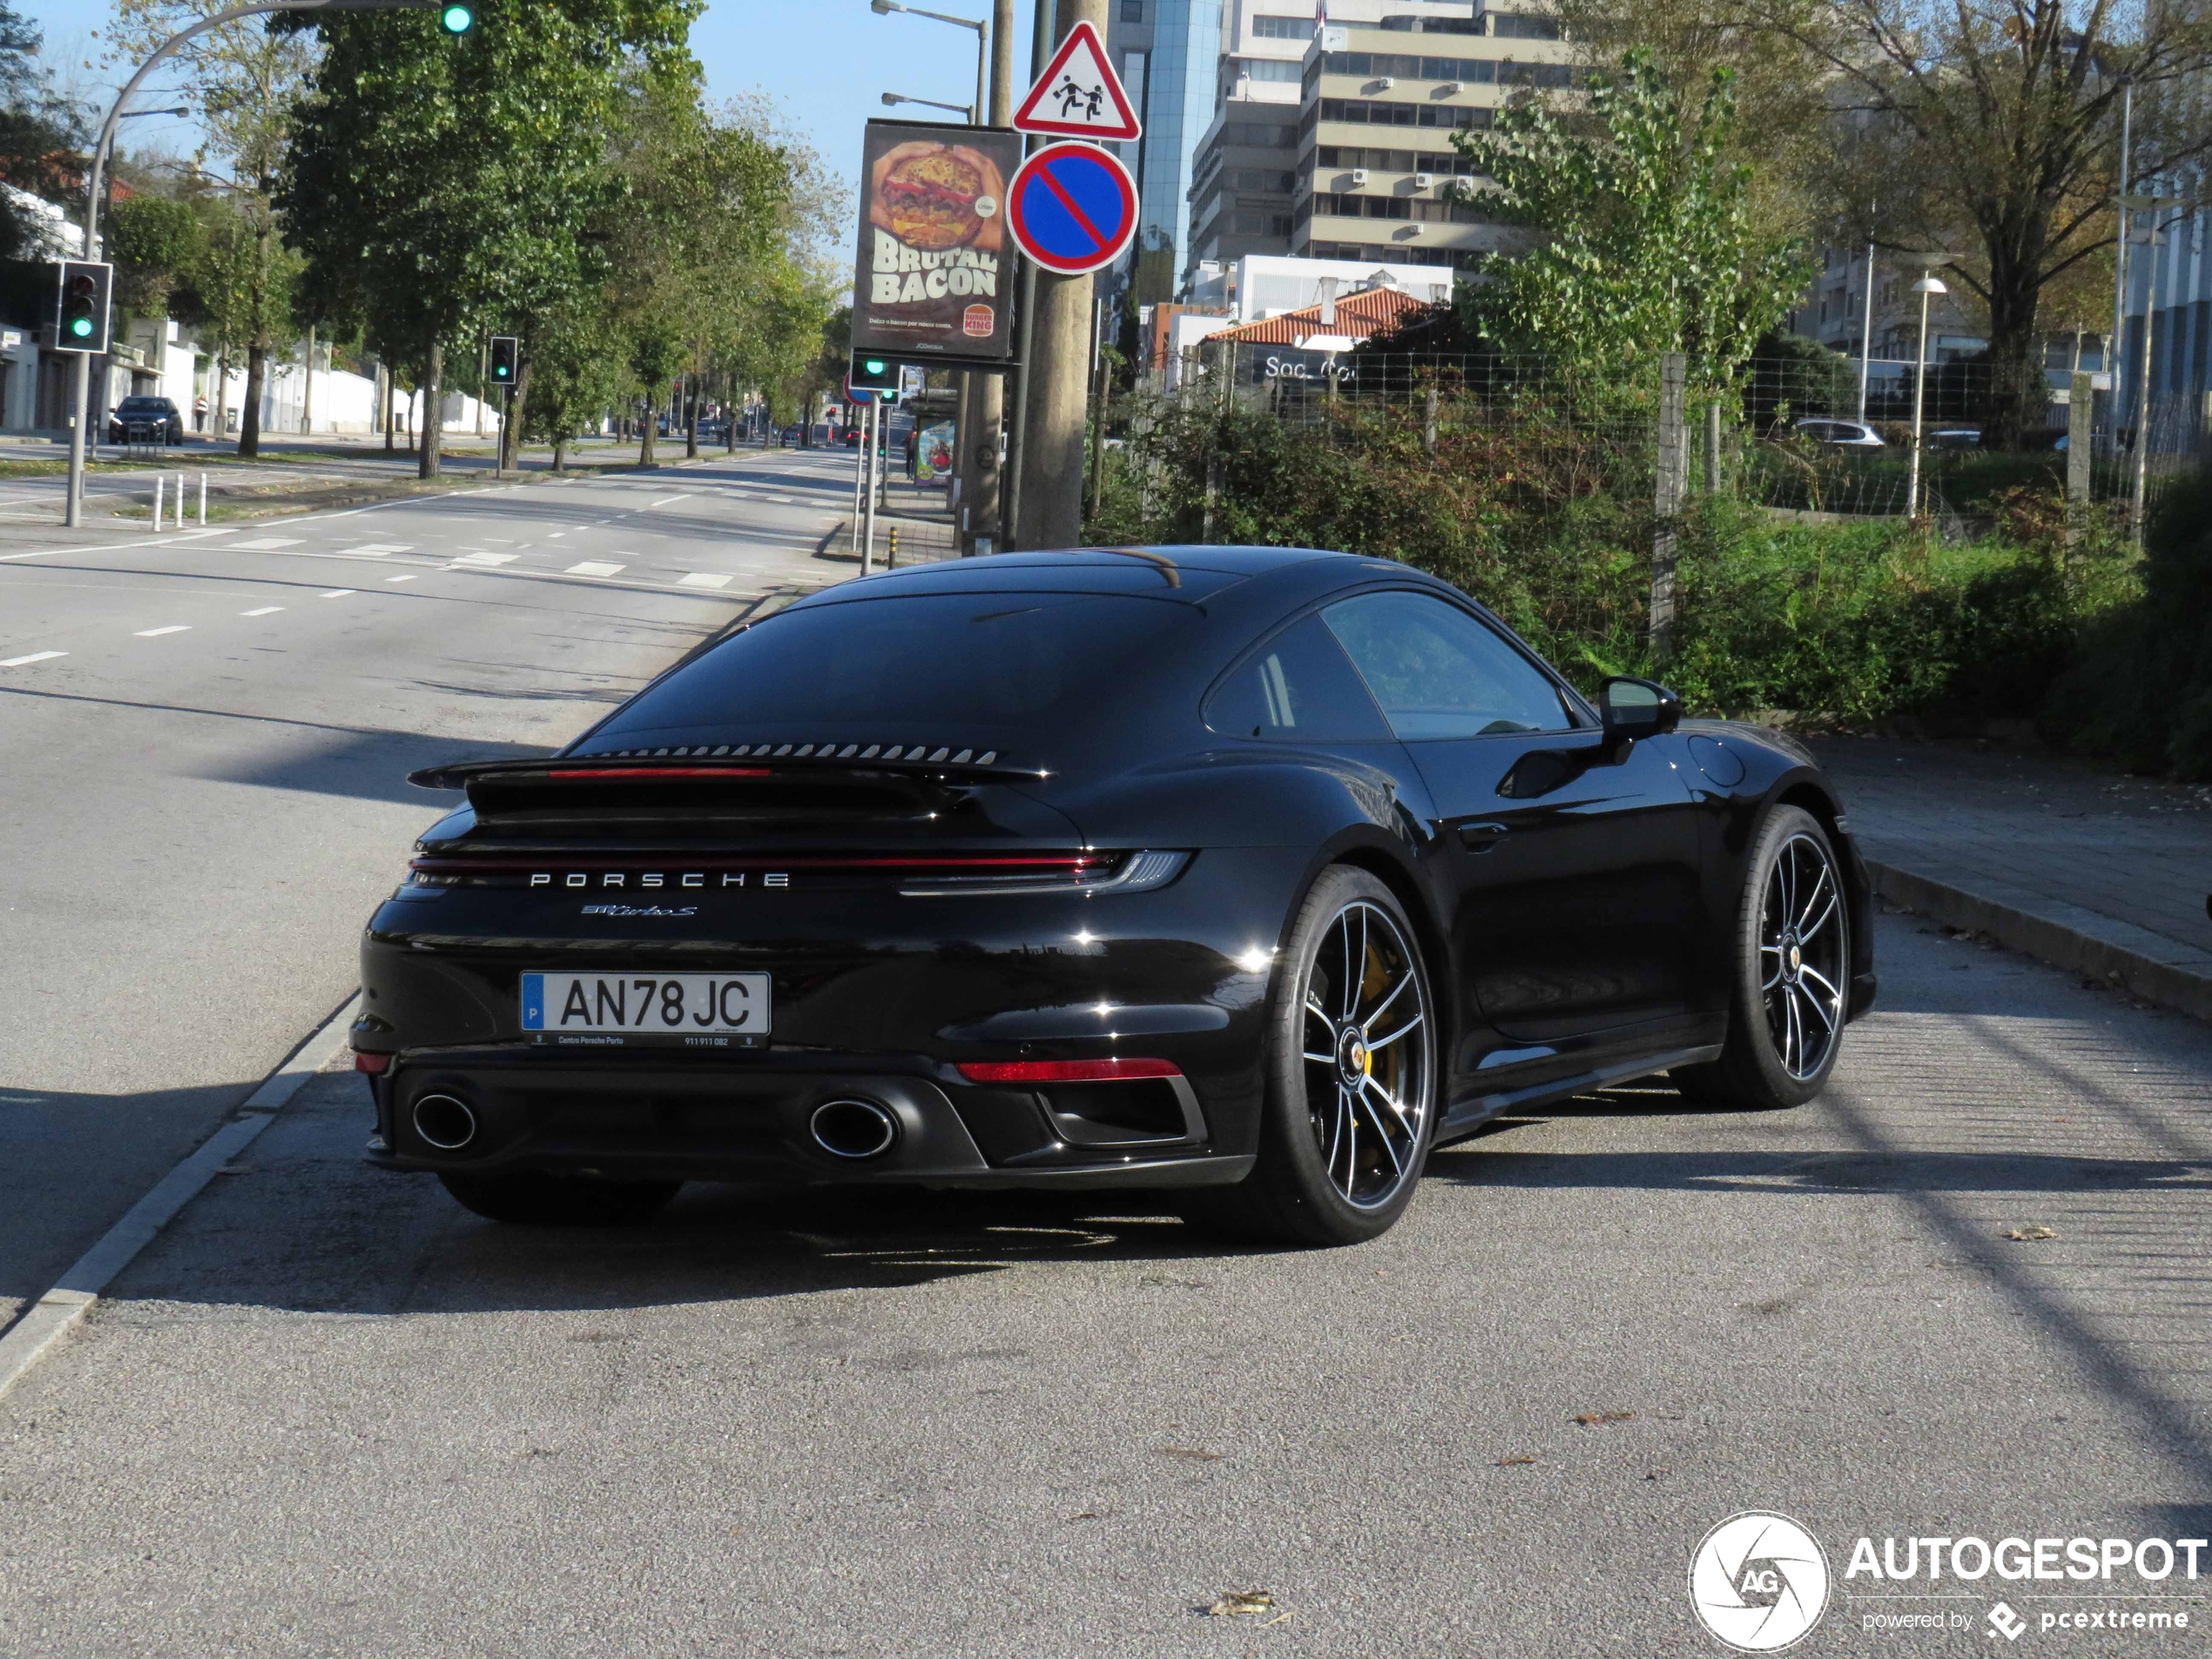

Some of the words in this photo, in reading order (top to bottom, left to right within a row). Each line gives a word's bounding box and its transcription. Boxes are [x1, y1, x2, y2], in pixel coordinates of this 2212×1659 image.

[873, 227, 998, 273] BRUTAL
[871, 267, 996, 304] BACON
[965, 320, 992, 330] KING
[530, 873, 789, 887] PORSCHE
[529, 1008, 538, 1020] P
[558, 1035, 580, 1044] Centro
[606, 1036, 624, 1045] Porto
[714, 1037, 728, 1046] 082
